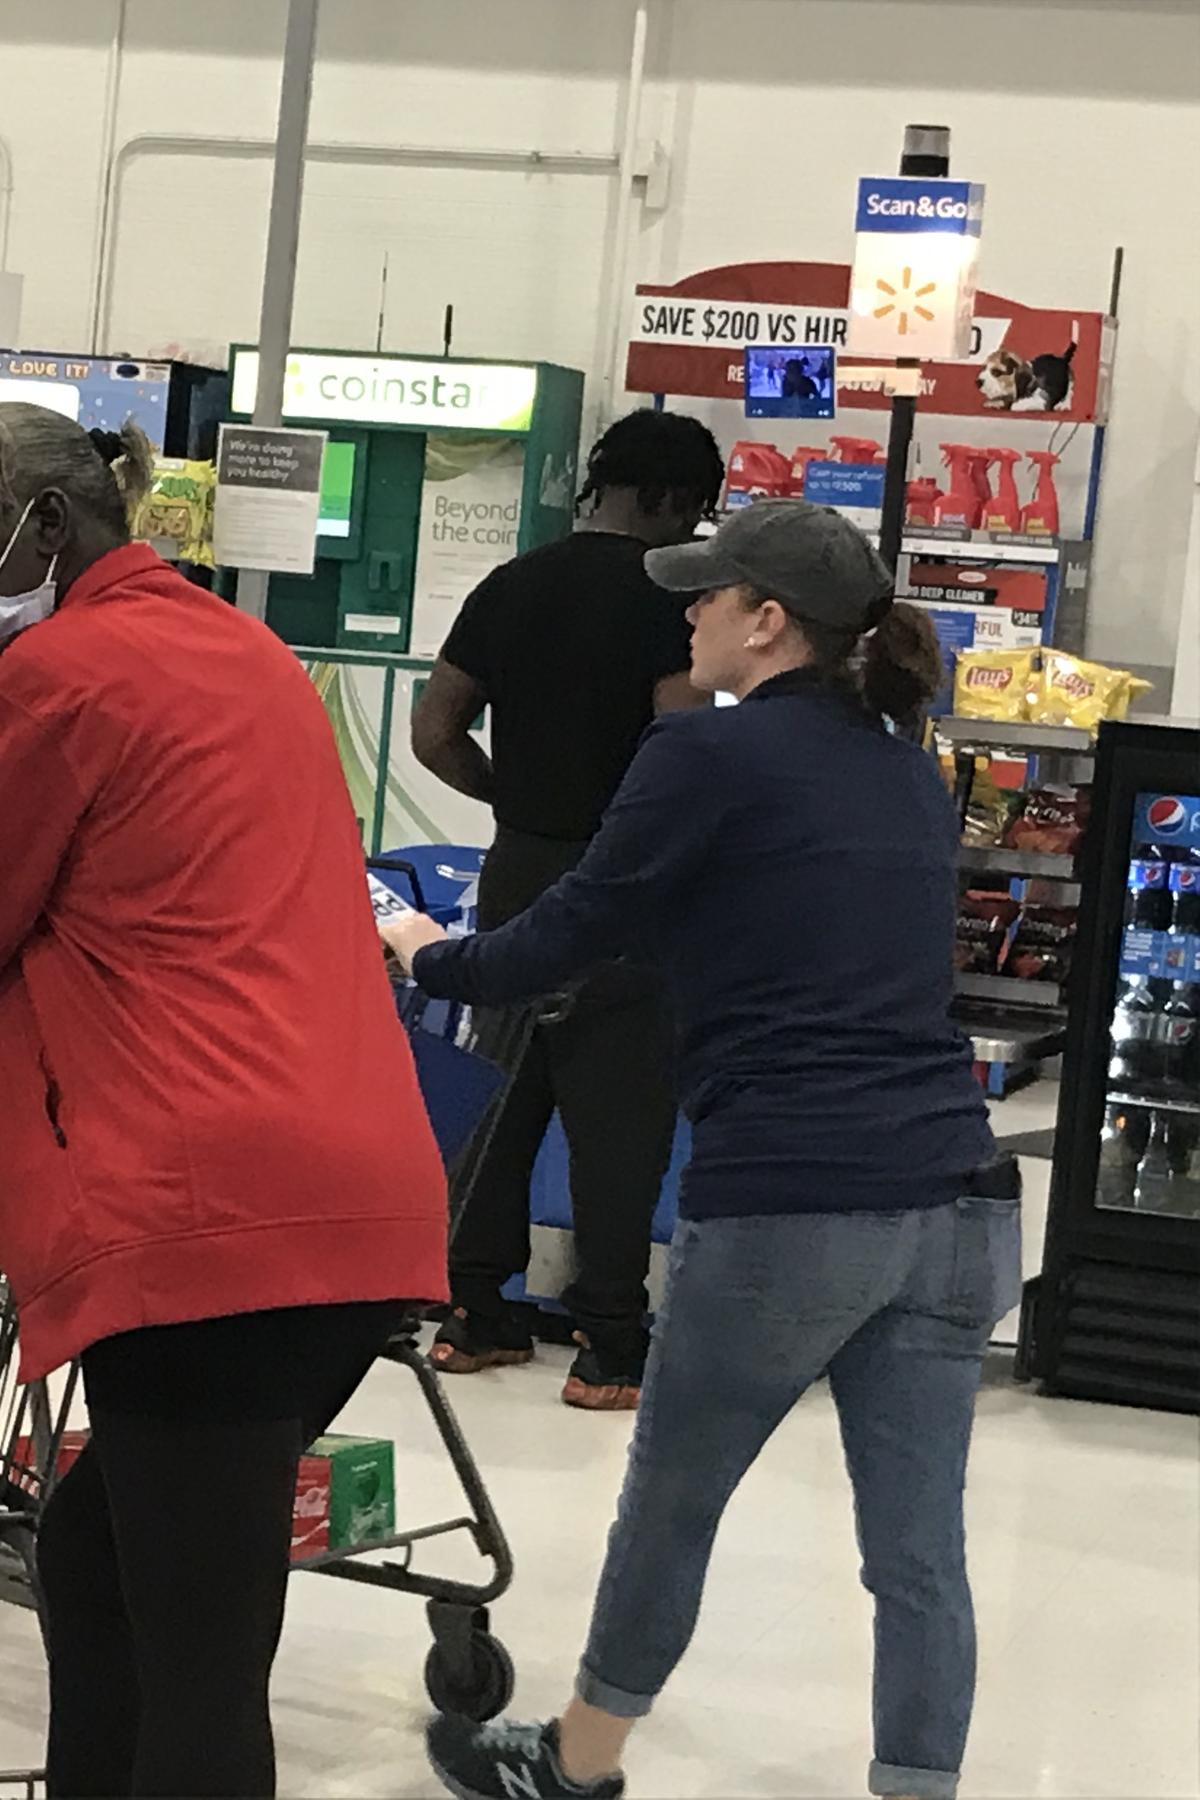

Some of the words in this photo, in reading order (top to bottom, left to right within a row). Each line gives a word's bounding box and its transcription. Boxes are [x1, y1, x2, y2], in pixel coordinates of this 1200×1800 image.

[867, 194, 967, 218] Scan&Go
[642, 304, 696, 335] SAVE
[702, 306, 760, 342] $200
[767, 313, 797, 343] VS
[9, 360, 57, 377] LOVE
[65, 362, 90, 378] IT!
[434, 495, 518, 523] Beyond
[432, 520, 468, 543] the
[968, 666, 1011, 689] Lay's
